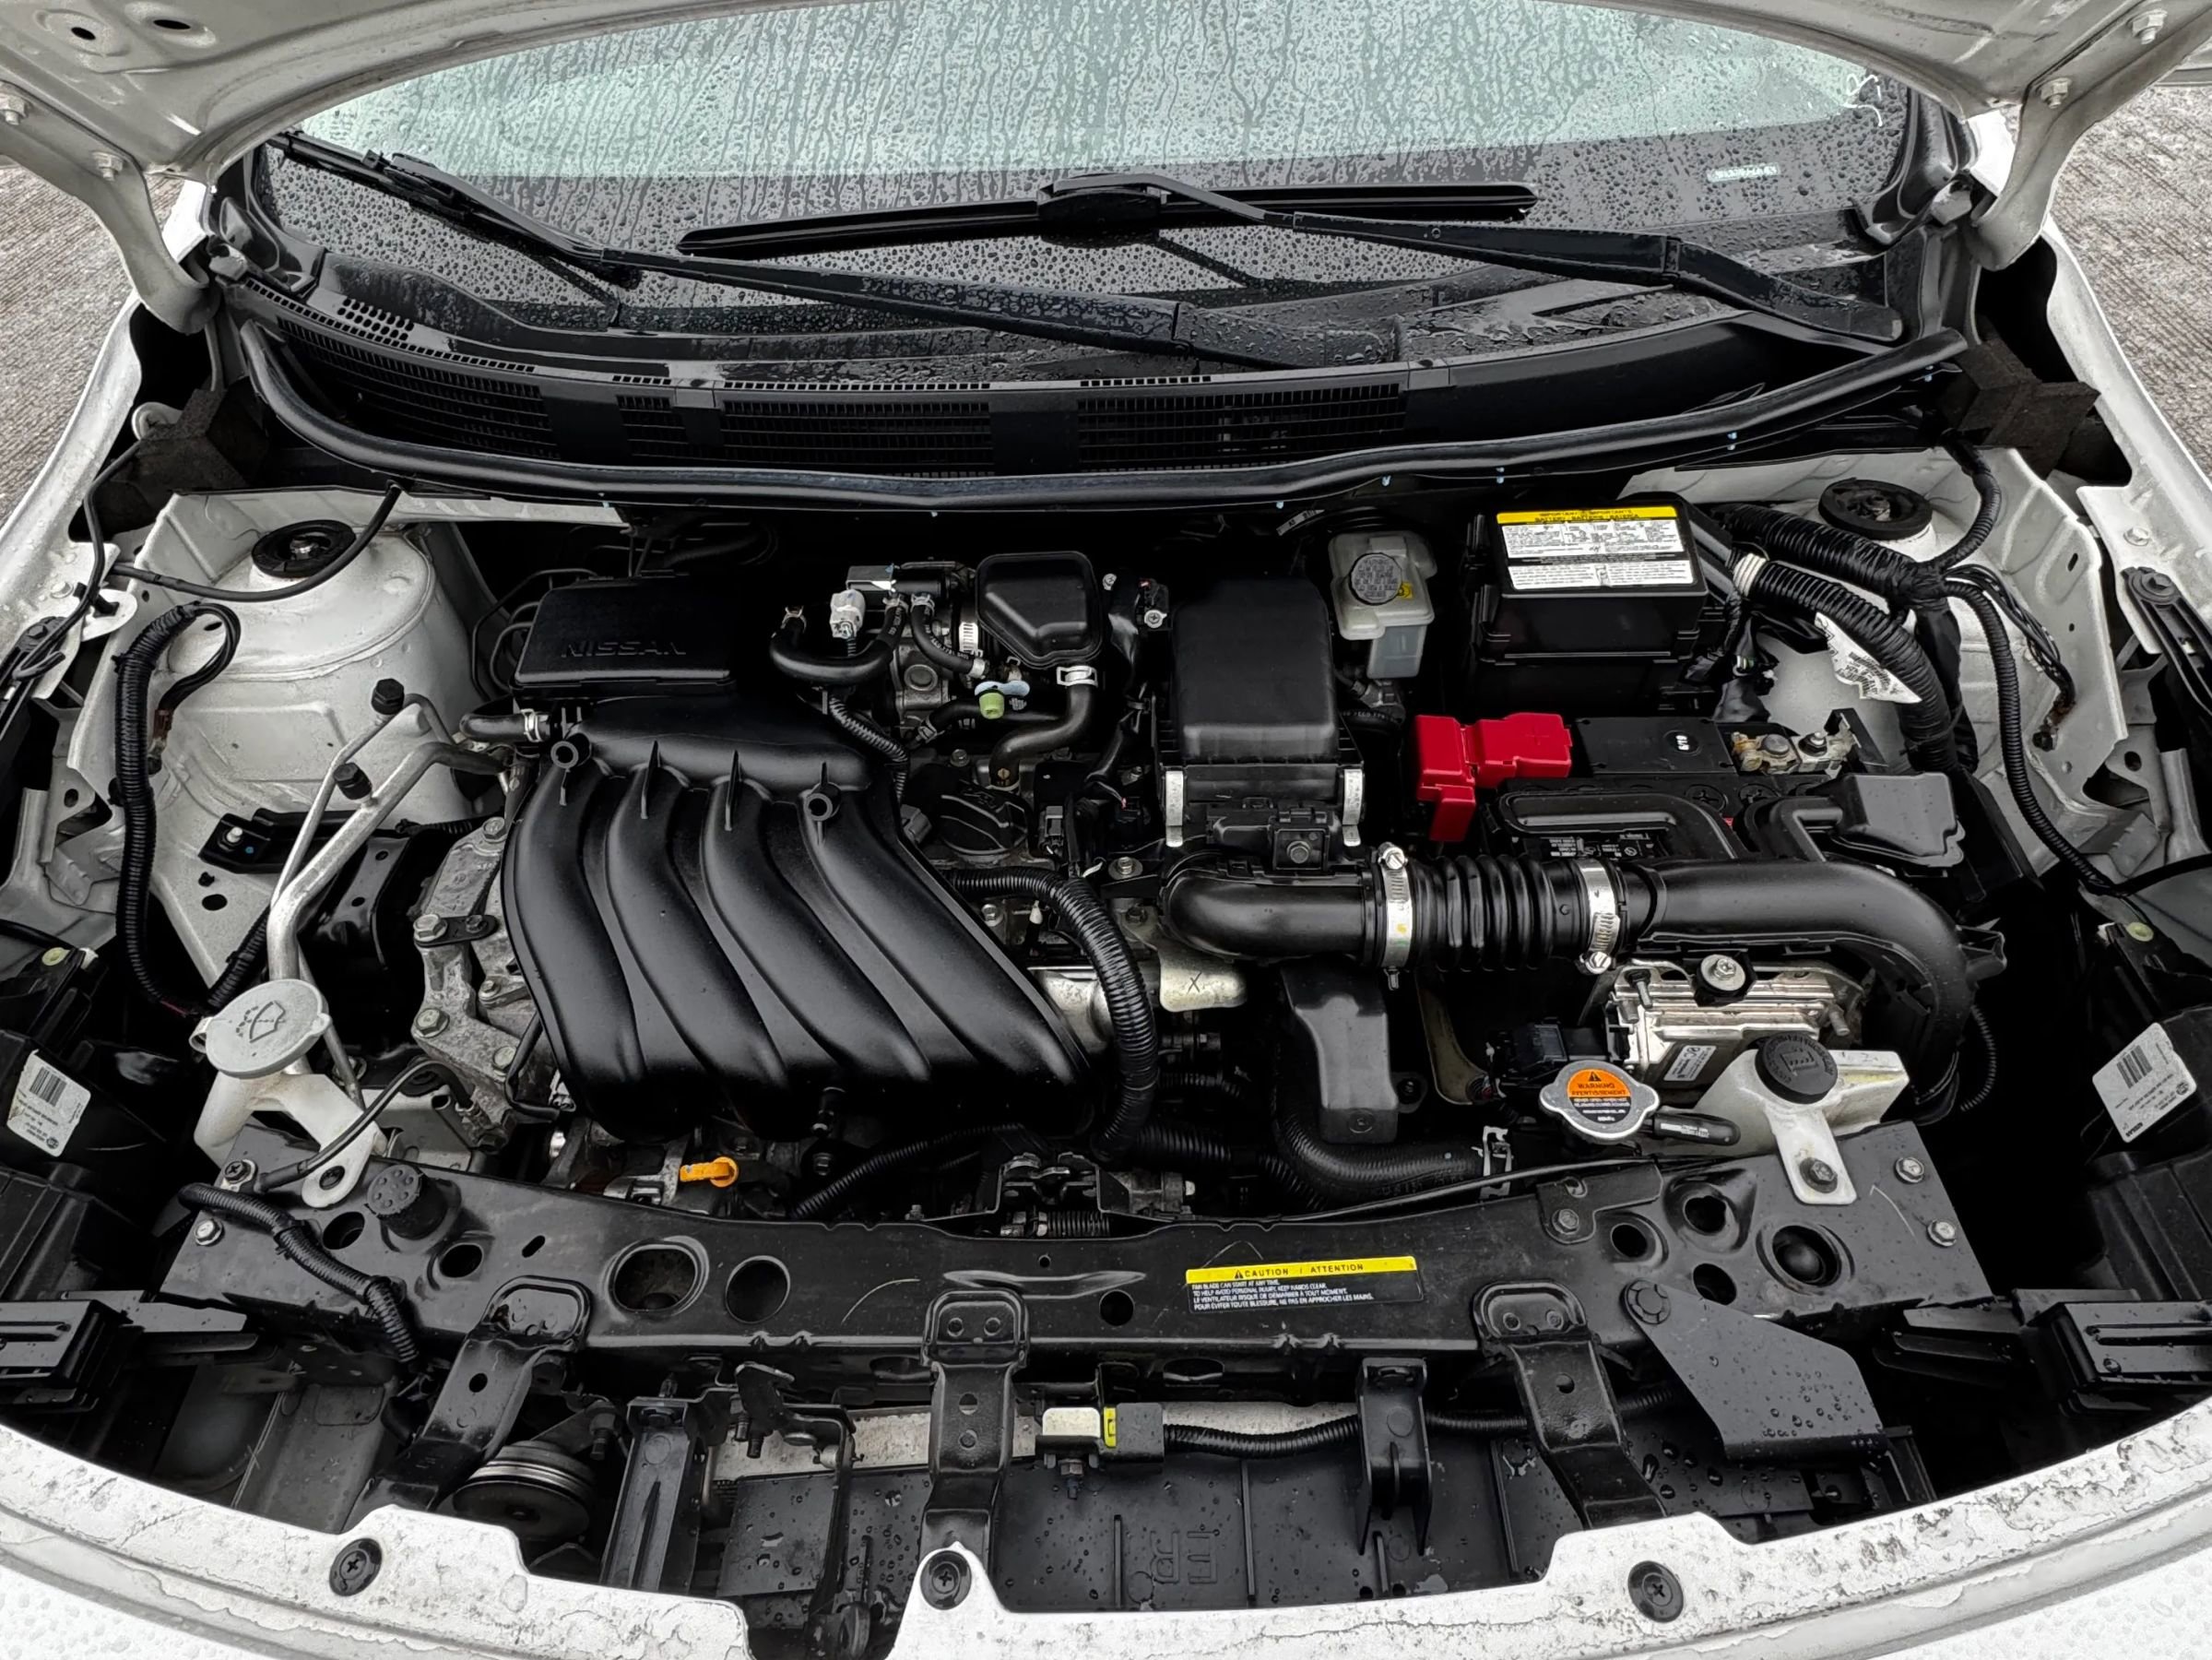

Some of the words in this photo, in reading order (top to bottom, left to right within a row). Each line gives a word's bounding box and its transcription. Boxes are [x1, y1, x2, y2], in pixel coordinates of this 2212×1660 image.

[561, 641, 686, 658] NISSAN
[1245, 1268, 1289, 1278] CAUTION
[1310, 1263, 1364, 1274] ATTENTION
[1201, 1295, 1237, 1303] VENTILATEUR
[1308, 1295, 1342, 1303] APPROCHER
